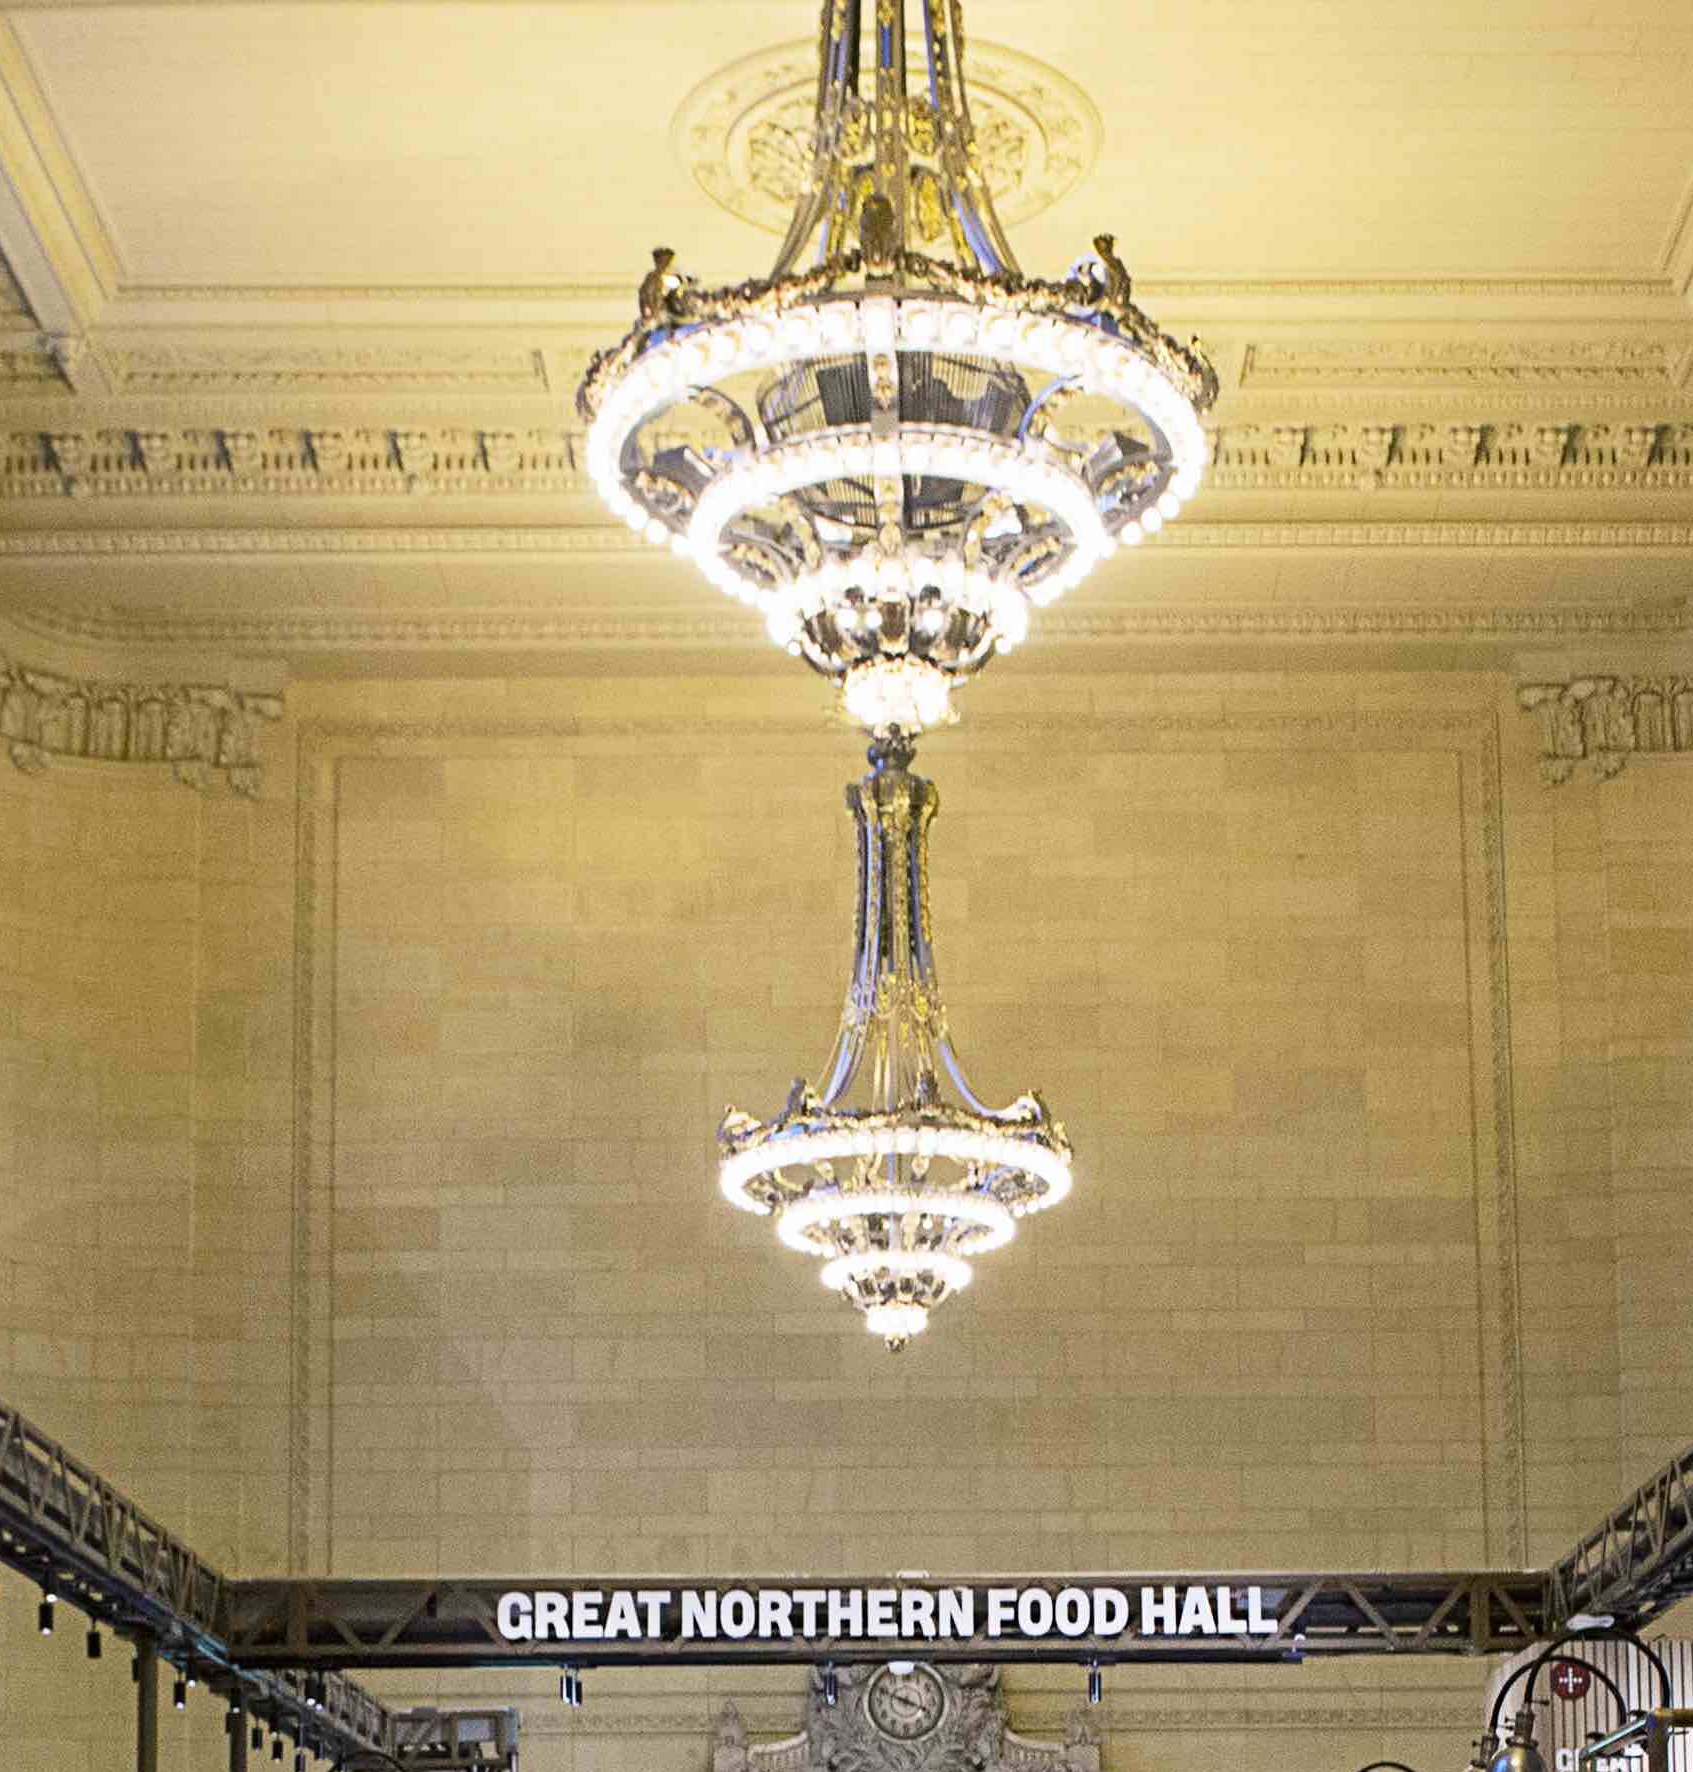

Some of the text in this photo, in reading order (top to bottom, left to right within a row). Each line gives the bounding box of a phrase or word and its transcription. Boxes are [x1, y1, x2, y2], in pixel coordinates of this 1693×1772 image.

[496, 1584, 1278, 1641] GREAT NORTHERN FOOD HALL
[1556, 1748, 1645, 1772] GEAT
